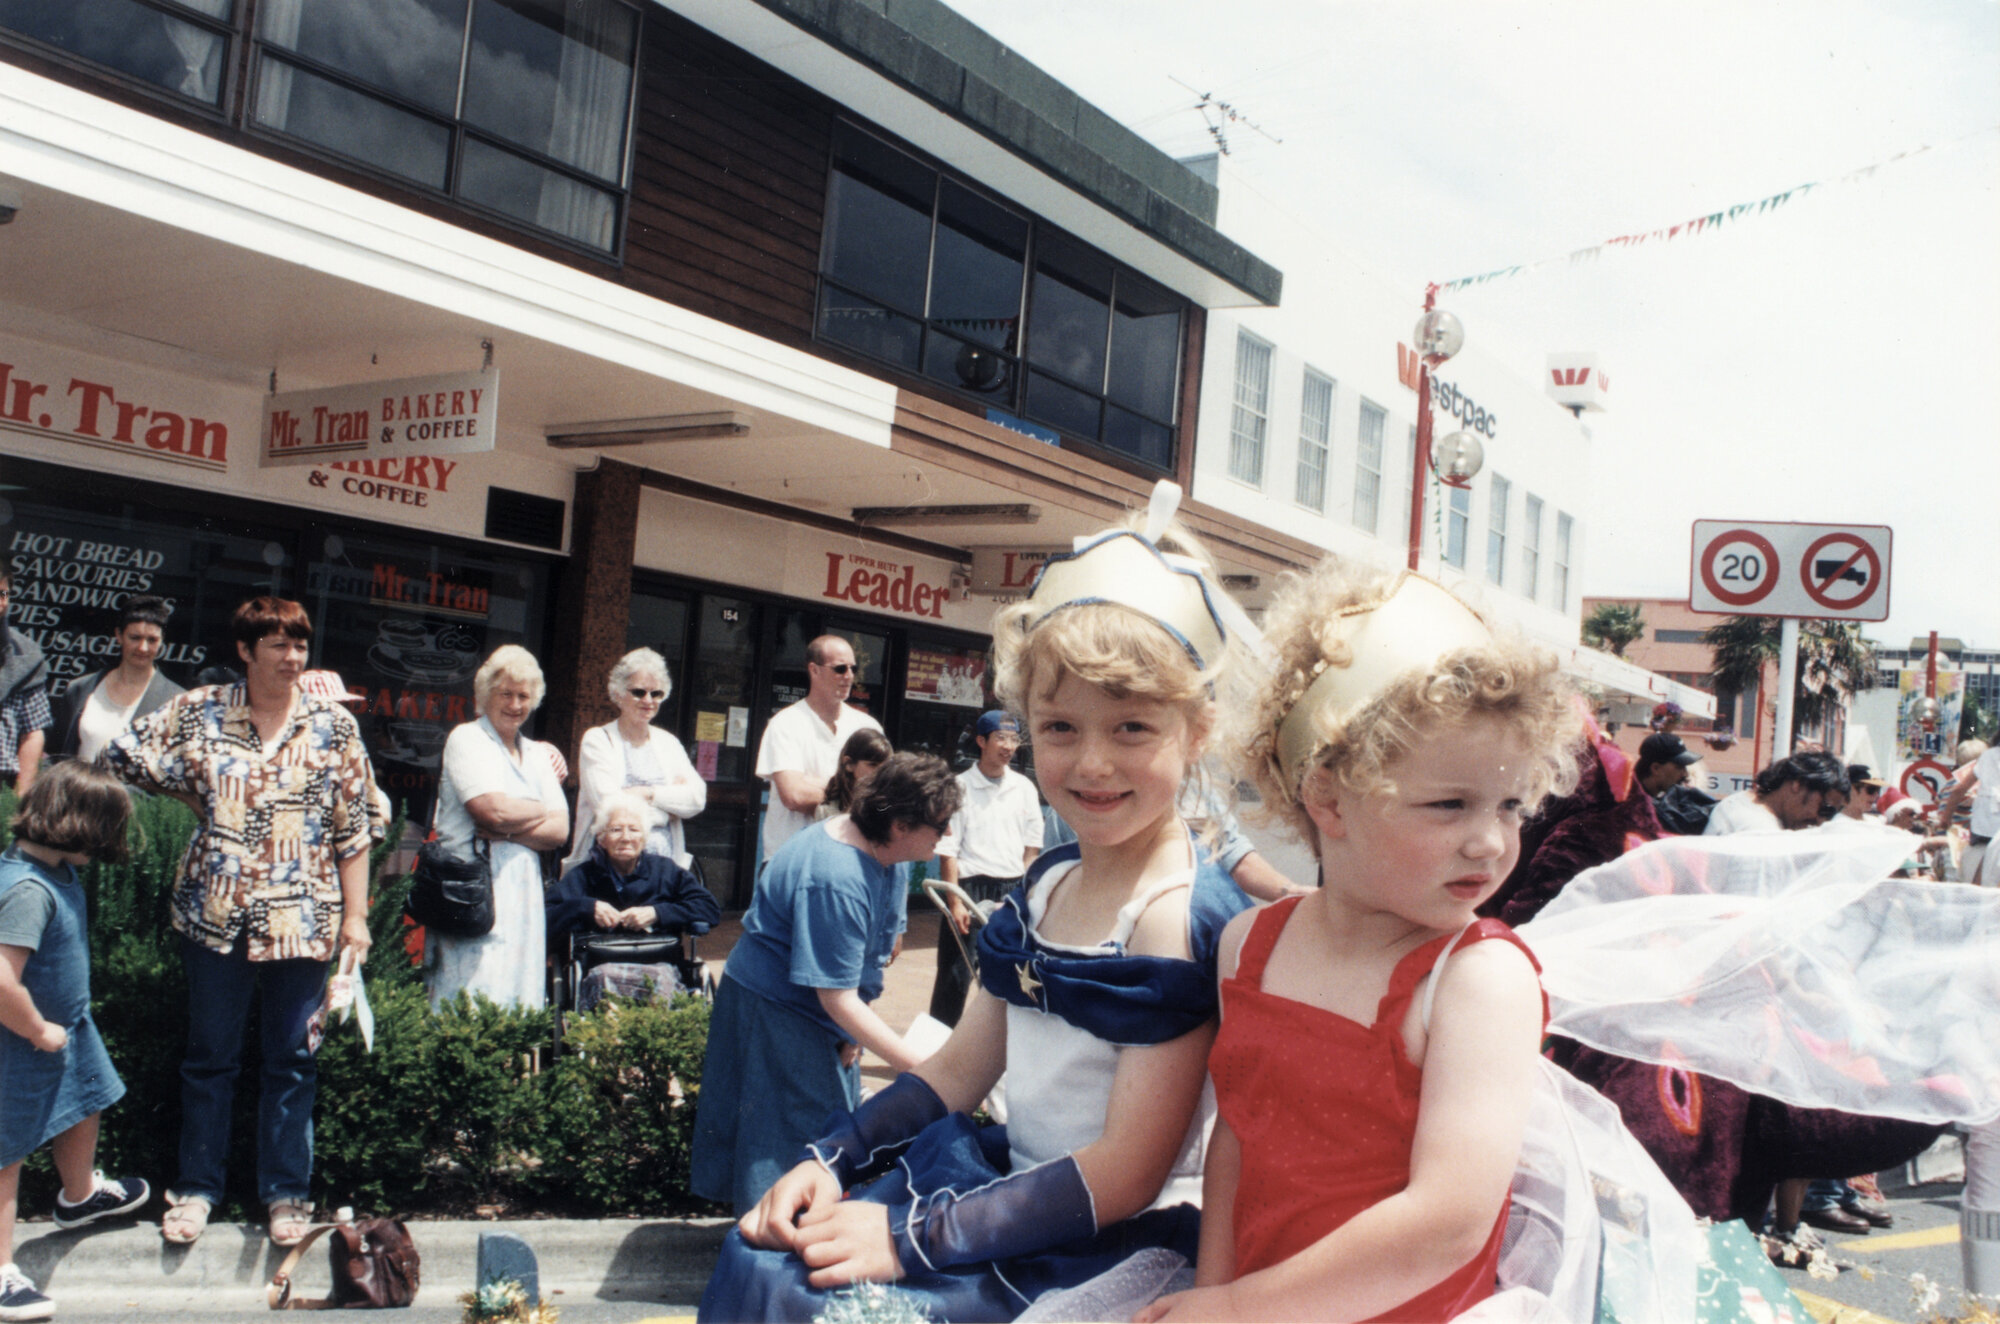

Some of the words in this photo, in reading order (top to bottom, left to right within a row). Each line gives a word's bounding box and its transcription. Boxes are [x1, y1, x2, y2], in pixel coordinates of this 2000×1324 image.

[67, 377, 228, 462] Tran
[381, 388, 483, 422] BAKERY
[269, 409, 301, 448] Mr.
[313, 406, 369, 444] Tran
[380, 427, 395, 443] &
[406, 418, 477, 441] COFFEE
[308, 469, 329, 488] &
[342, 476, 428, 507] COFFEE
[315, 455, 458, 492] ERY
[9, 531, 73, 557] HOT
[75, 540, 164, 570] BREAD
[849, 554, 875, 568] UPPER
[877, 560, 898, 573] HUTT
[1721, 553, 1761, 582] 20
[11, 555, 154, 591] SAVOURIES
[371, 563, 413, 601] Mr.
[426, 572, 488, 612] Tran
[823, 552, 950, 618] Leader
[6, 602, 63, 627] PIES
[8, 578, 177, 616] SANDWICS
[723, 609, 739, 622] 154
[23, 626, 123, 657] AUSAGE
[349, 685, 478, 723] BAKER
